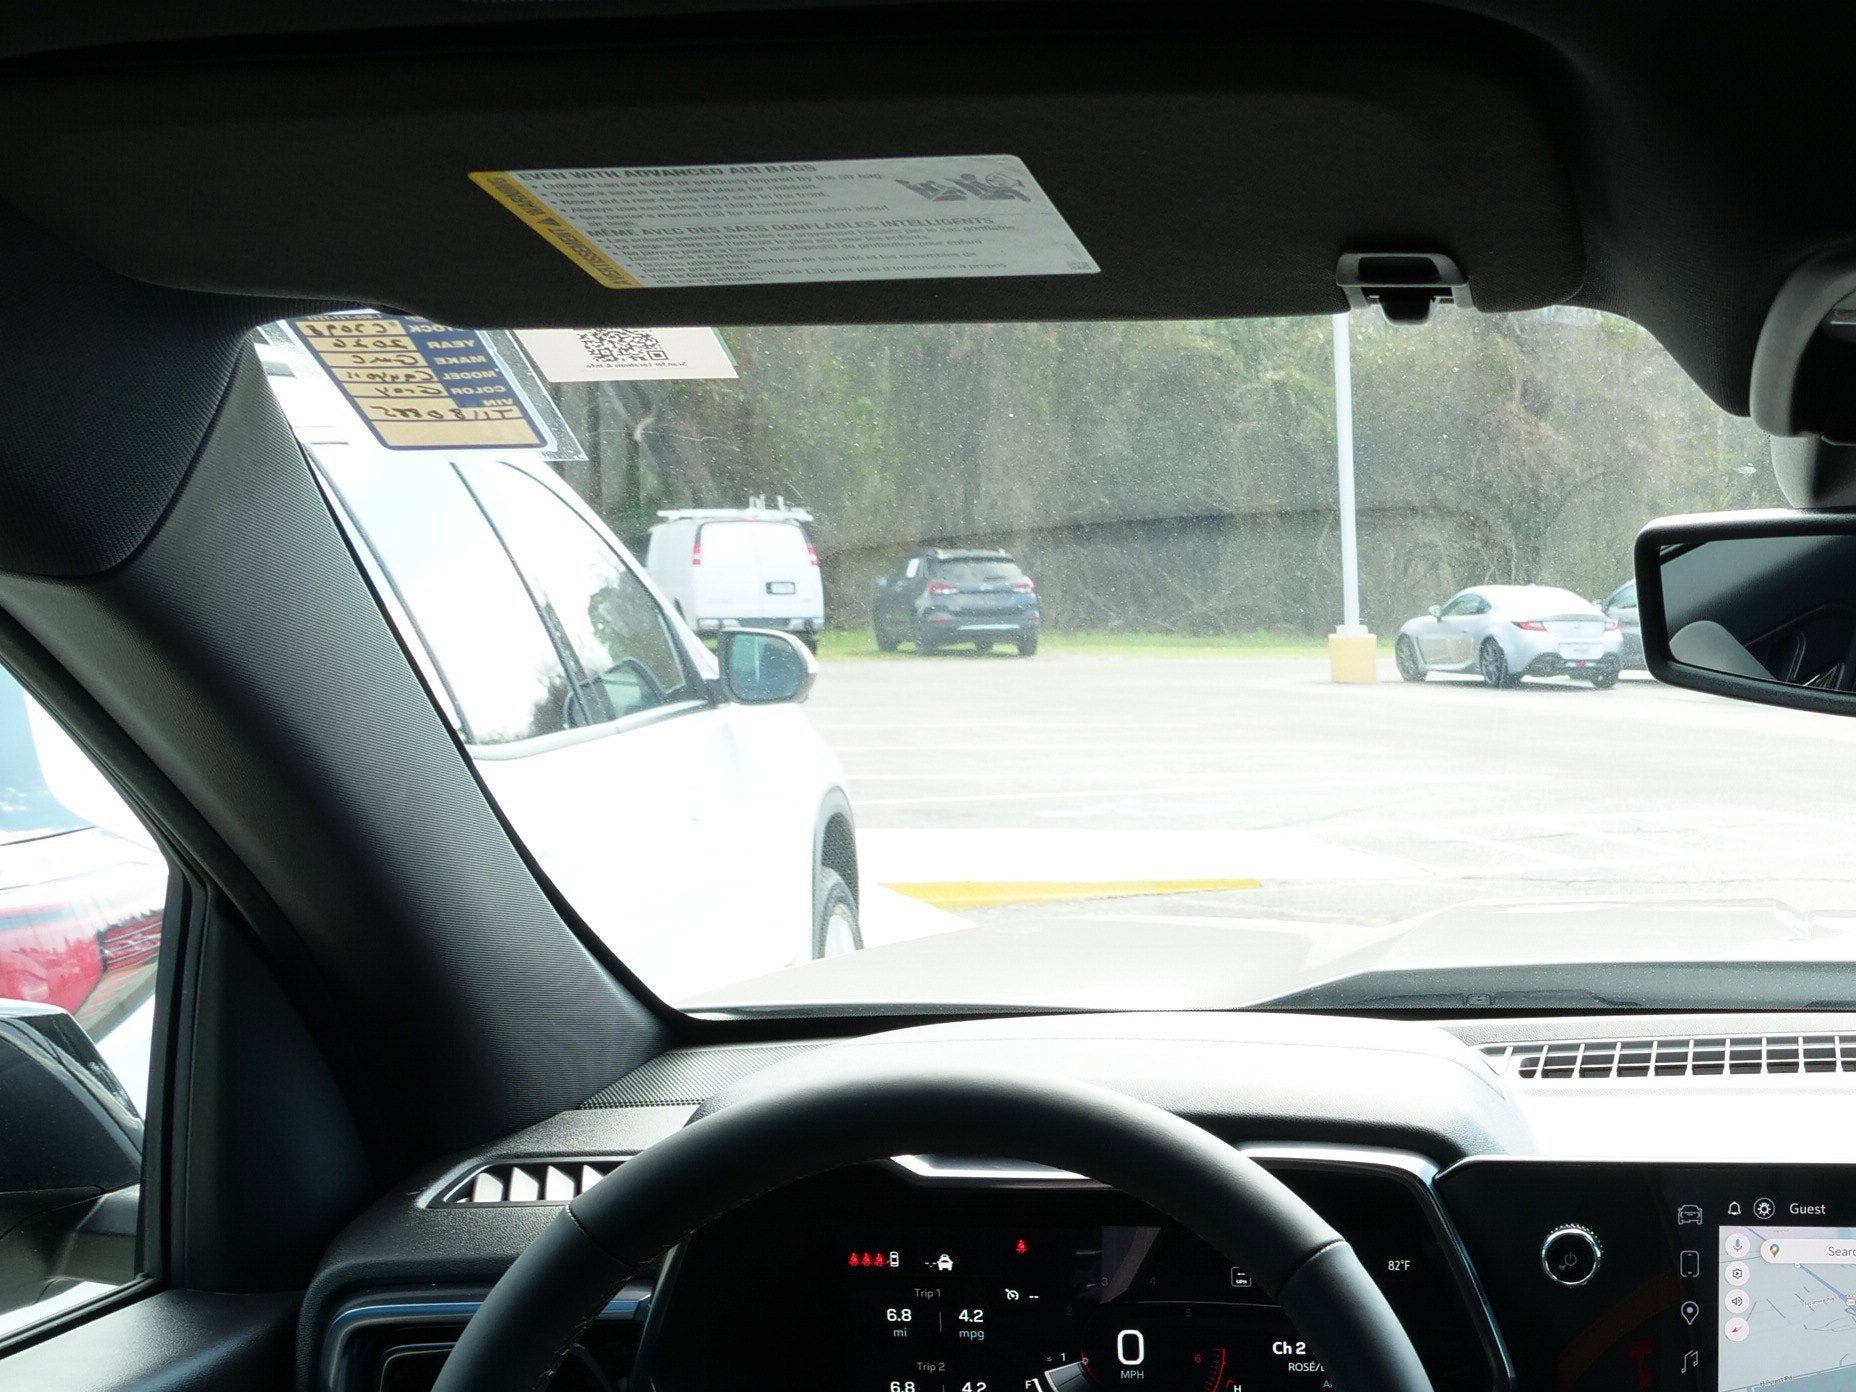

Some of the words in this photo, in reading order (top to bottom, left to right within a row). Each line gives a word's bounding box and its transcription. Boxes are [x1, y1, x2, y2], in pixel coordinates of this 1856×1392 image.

[515, 171, 569, 181] EVEN
[568, 169, 621, 179] WITH
[619, 166, 725, 177] ADVANCED
[725, 165, 762, 174] AIR
[762, 163, 819, 173] BAGS
[1789, 1203, 1826, 1215] Guest
[1388, 1260, 1411, 1271] 82°F
[914, 1288, 934, 1300] Trip
[886, 1308, 912, 1322] 6.8
[958, 1309, 984, 1323] 4.2
[893, 1327, 908, 1338] mi
[958, 1329, 985, 1341] mpg
[1117, 1329, 1145, 1366] 0
[1272, 1341, 1292, 1355] Ch
[1295, 1341, 1306, 1355] 2
[916, 1362, 937, 1373] Trip
[939, 1362, 946, 1371] 2
[1120, 1370, 1145, 1379] MPH
[1024, 1380, 1031, 1390] F
